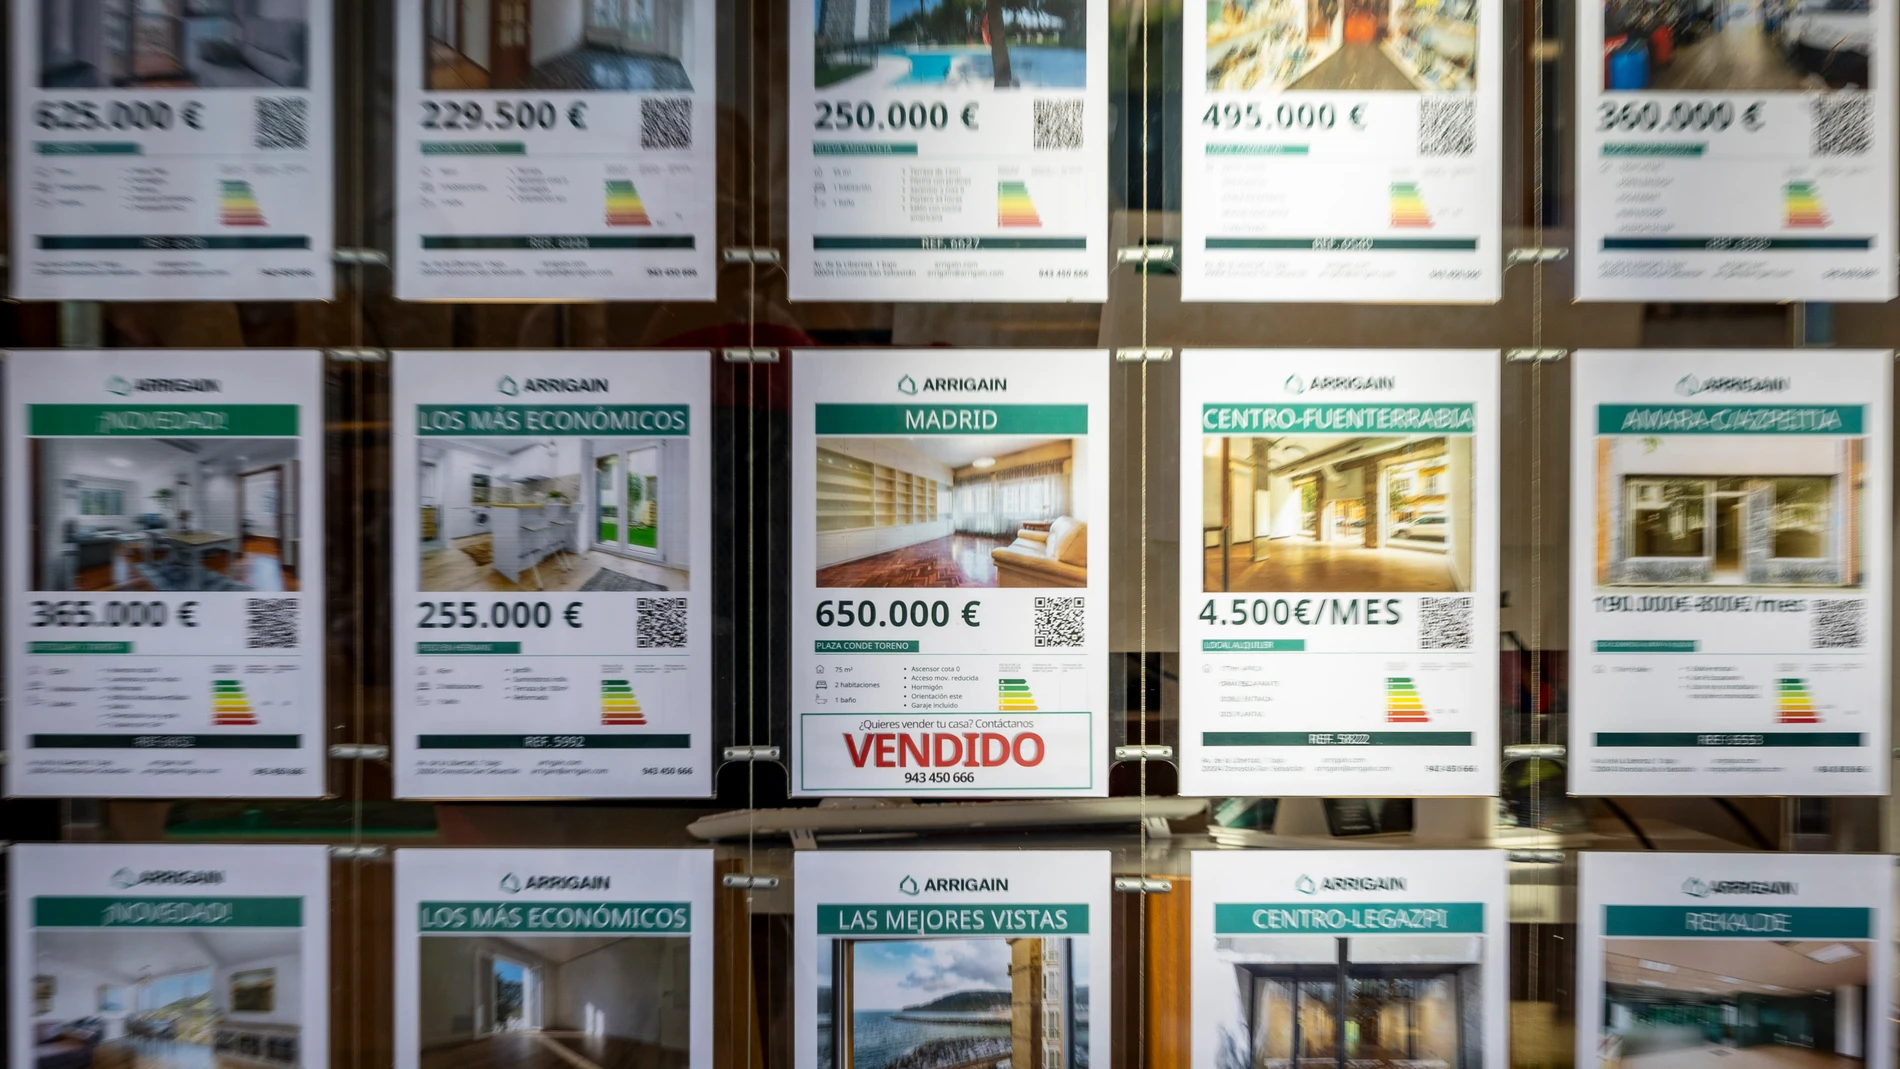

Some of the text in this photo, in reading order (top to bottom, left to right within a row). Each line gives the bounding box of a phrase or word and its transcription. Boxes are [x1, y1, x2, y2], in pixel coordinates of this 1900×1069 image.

[33, 100, 205, 131] 625.000 €
[420, 100, 588, 130] 229.500 €
[814, 101, 979, 131] 250.000 €
[1202, 102, 1368, 130] 495.000 €
[1596, 101, 1766, 131] 360.000 €
[524, 378, 609, 393] ARRIGAIN
[923, 378, 1007, 392] ARRIGAIN
[1310, 376, 1394, 391] ARRIGAIN
[420, 405, 686, 430] LOS MÁS ECONÓMICOS
[905, 410, 998, 430] MADRID
[30, 601, 201, 627] 365.000 €
[416, 601, 583, 628] 255.000 €
[816, 600, 981, 627] 650.000 €
[1199, 599, 1402, 625] 4.500€/MES
[816, 642, 908, 650] PLAZA CONDE TORENO
[911, 684, 943, 692] Hormigón
[859, 719, 1034, 730] ¿Quieres vender tu casa? Contáctanos
[523, 736, 551, 747] REF.
[843, 732, 1045, 768] VENDIDO
[904, 772, 974, 783] 943 450 666
[525, 875, 610, 891] ARRIGAIN
[924, 878, 1008, 892] ARRIGAIN
[1321, 877, 1407, 892] ARRIGAIN
[421, 902, 687, 929] LOS MÁS ECONÓMICOS
[839, 910, 1068, 935] LAS MEJORES VISTAS
[1253, 909, 1448, 930] CENTRO-LEGAZPI
